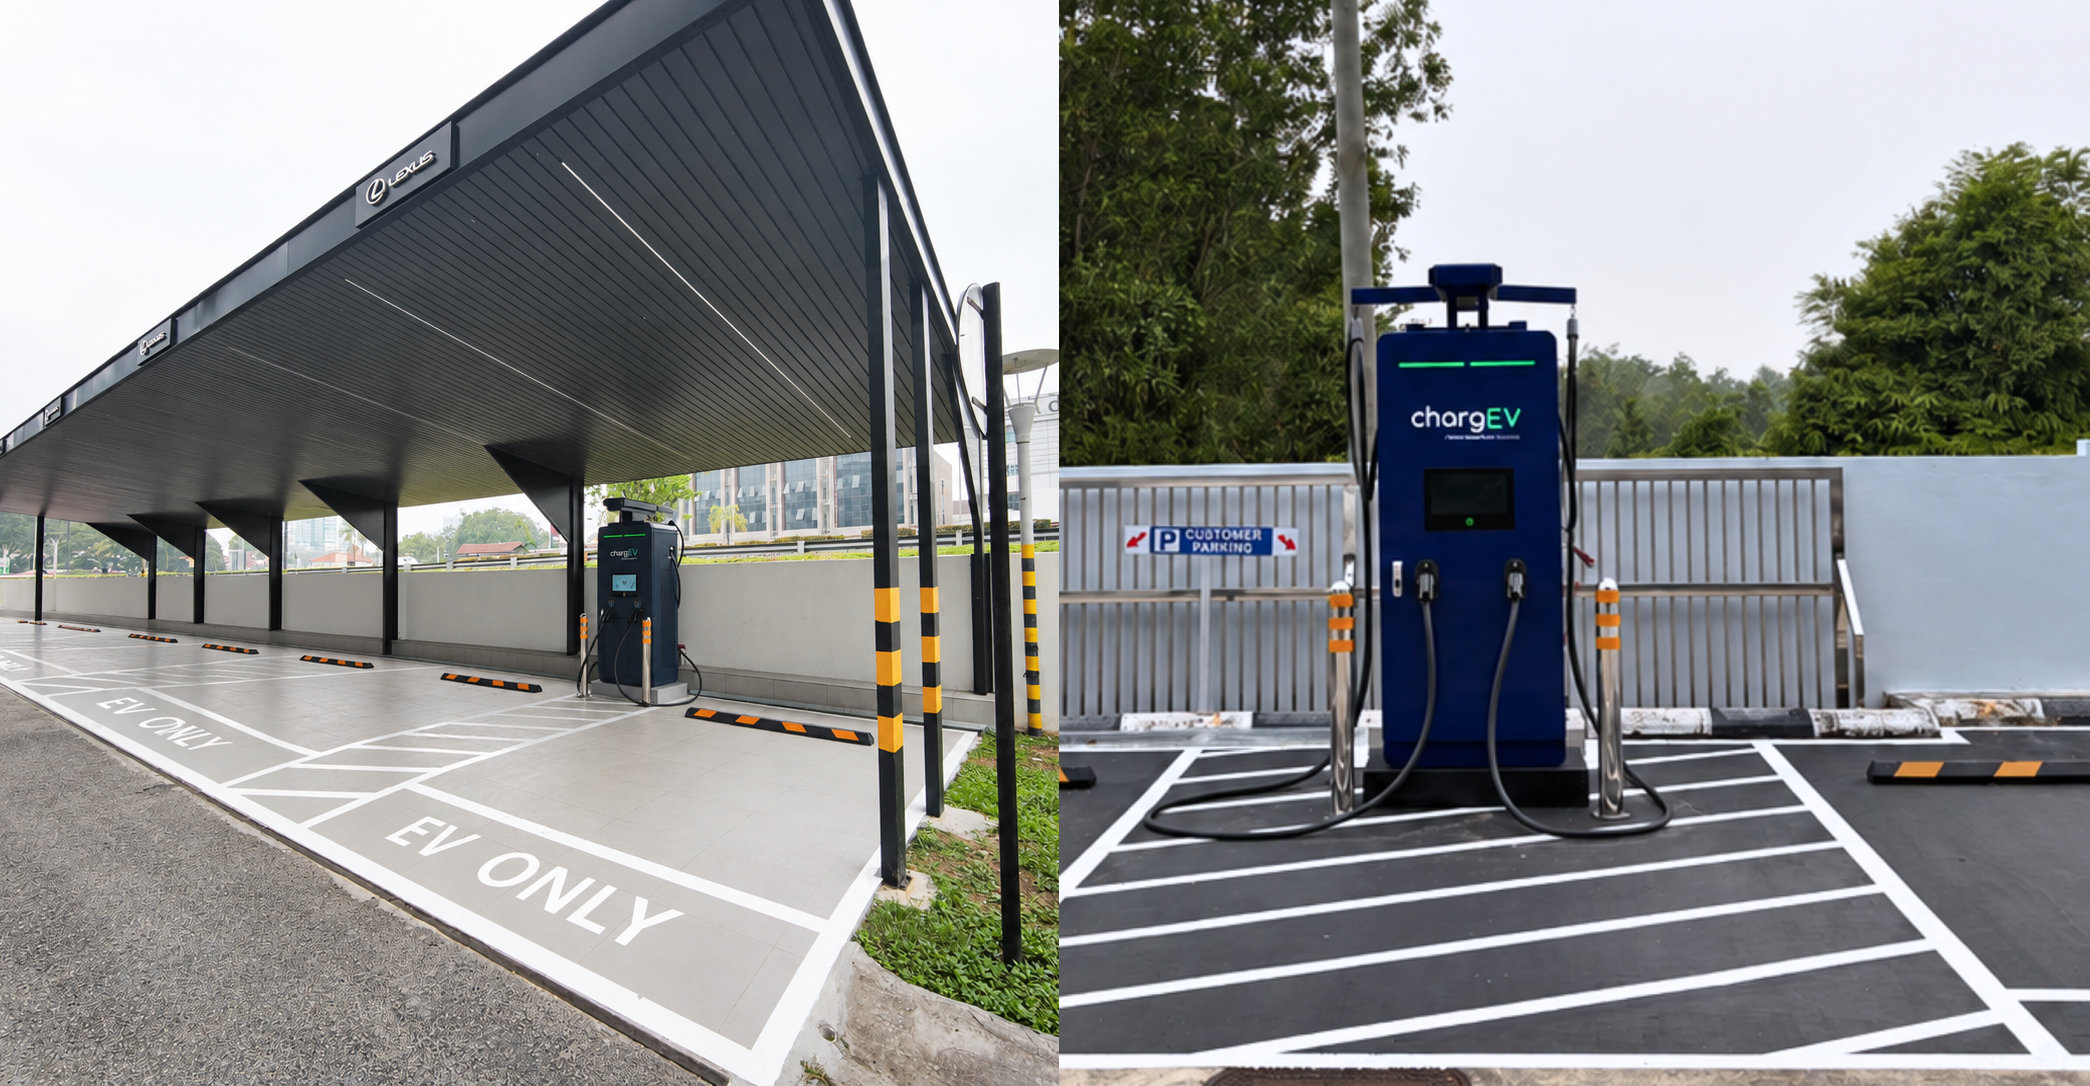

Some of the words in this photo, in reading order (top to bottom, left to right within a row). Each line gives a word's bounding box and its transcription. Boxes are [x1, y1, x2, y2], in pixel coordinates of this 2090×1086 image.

[388, 150, 435, 187] LEXUS
[1410, 405, 1521, 433] chargEV
[1160, 531, 1176, 550] P
[1185, 529, 1262, 541] CUSTOMER
[1192, 541, 1253, 553] PARKING
[96, 697, 156, 715] EV
[138, 716, 233, 750] ONLY
[384, 816, 482, 857] EV
[477, 852, 685, 946] ONLY
